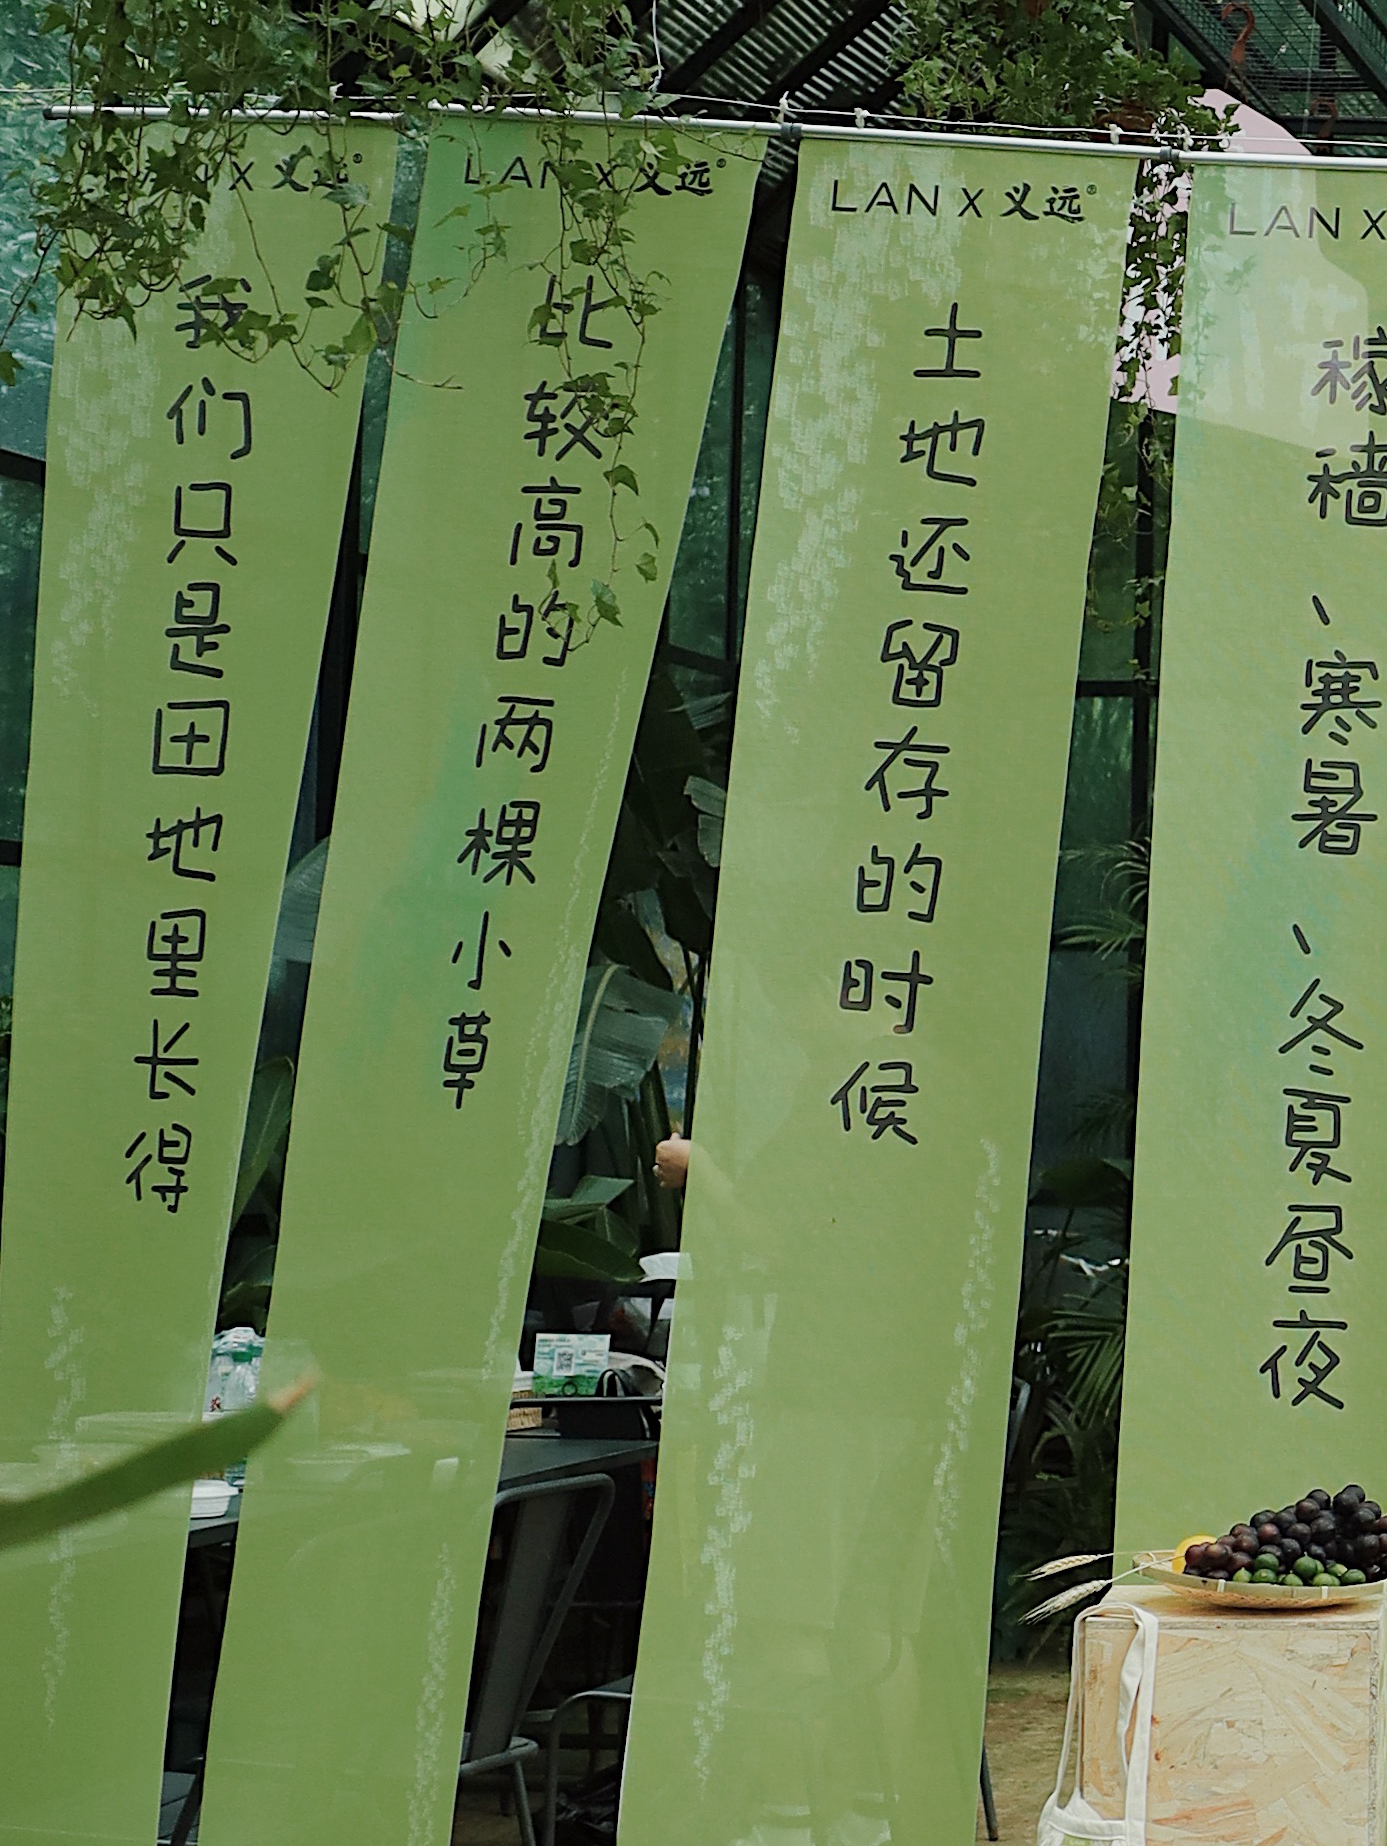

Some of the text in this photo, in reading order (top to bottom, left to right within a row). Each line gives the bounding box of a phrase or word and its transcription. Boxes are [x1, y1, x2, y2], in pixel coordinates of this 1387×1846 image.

[831, 179, 940, 217] LAN
[1229, 205, 1341, 241] LAN
[829, 301, 986, 1146] 土地还留存的时候
